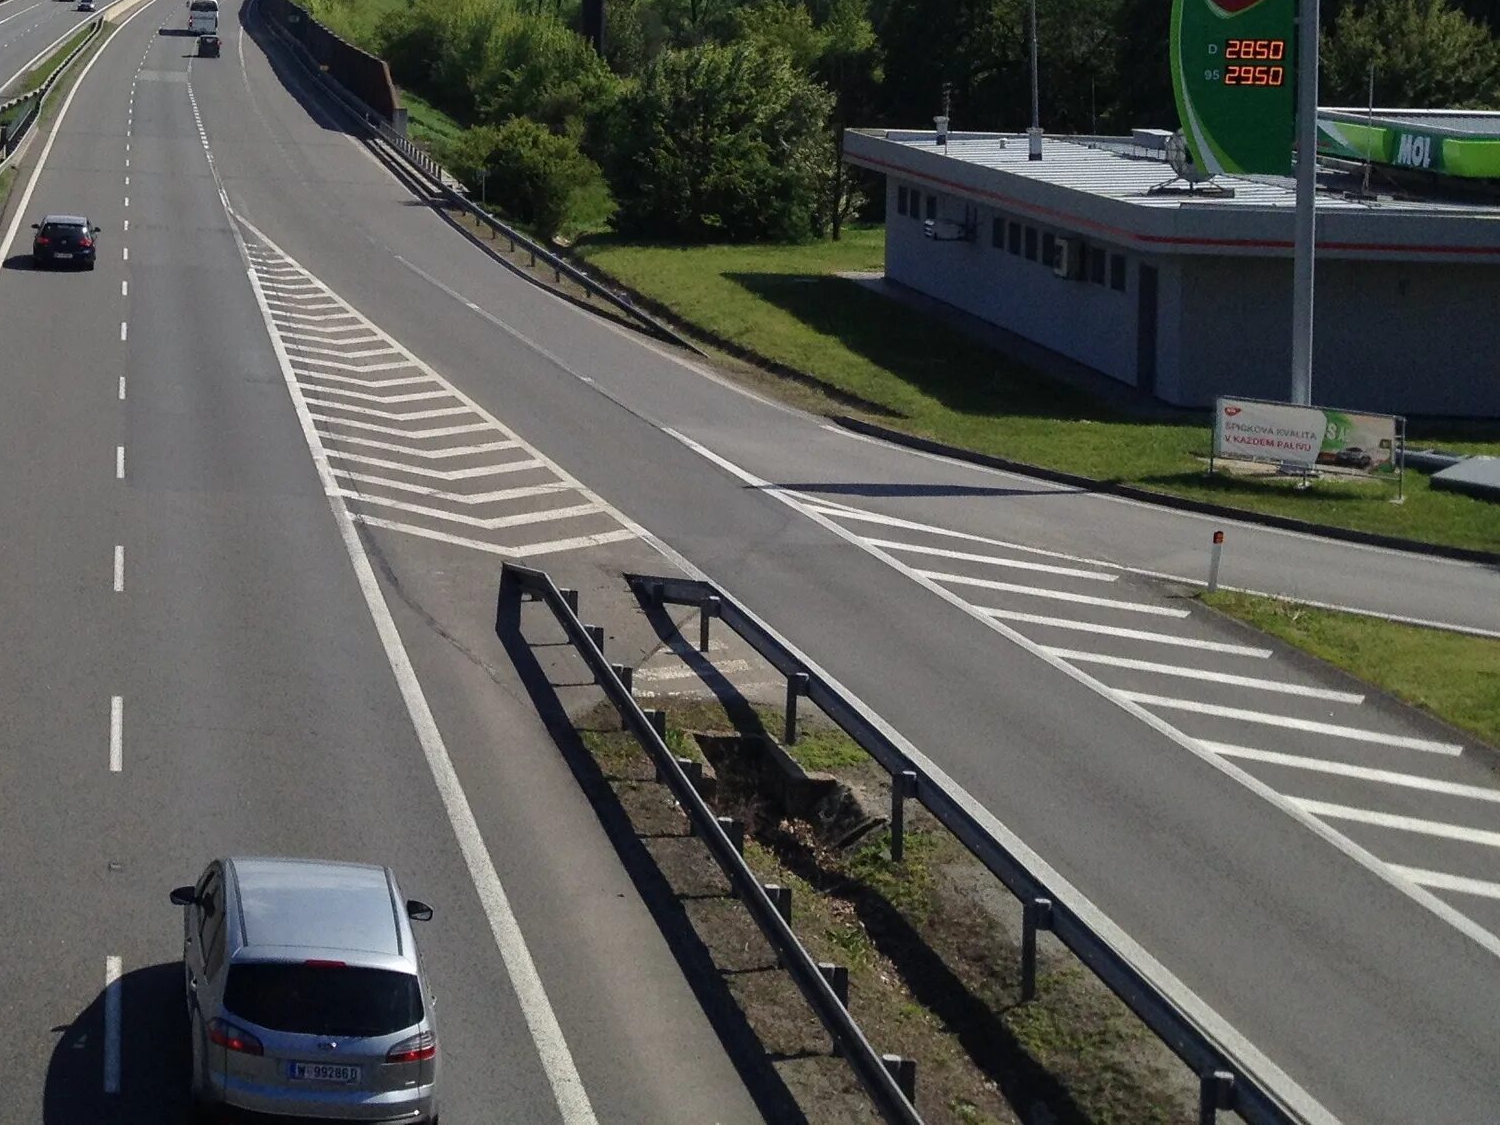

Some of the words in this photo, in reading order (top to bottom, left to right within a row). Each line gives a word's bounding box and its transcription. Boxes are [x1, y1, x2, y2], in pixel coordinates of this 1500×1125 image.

[1208, 43, 1218, 55] D
[1204, 69, 1220, 81] 95
[1398, 133, 1431, 168] MOL
[1224, 434, 1231, 442] V
[297, 1065, 306, 1076] W
